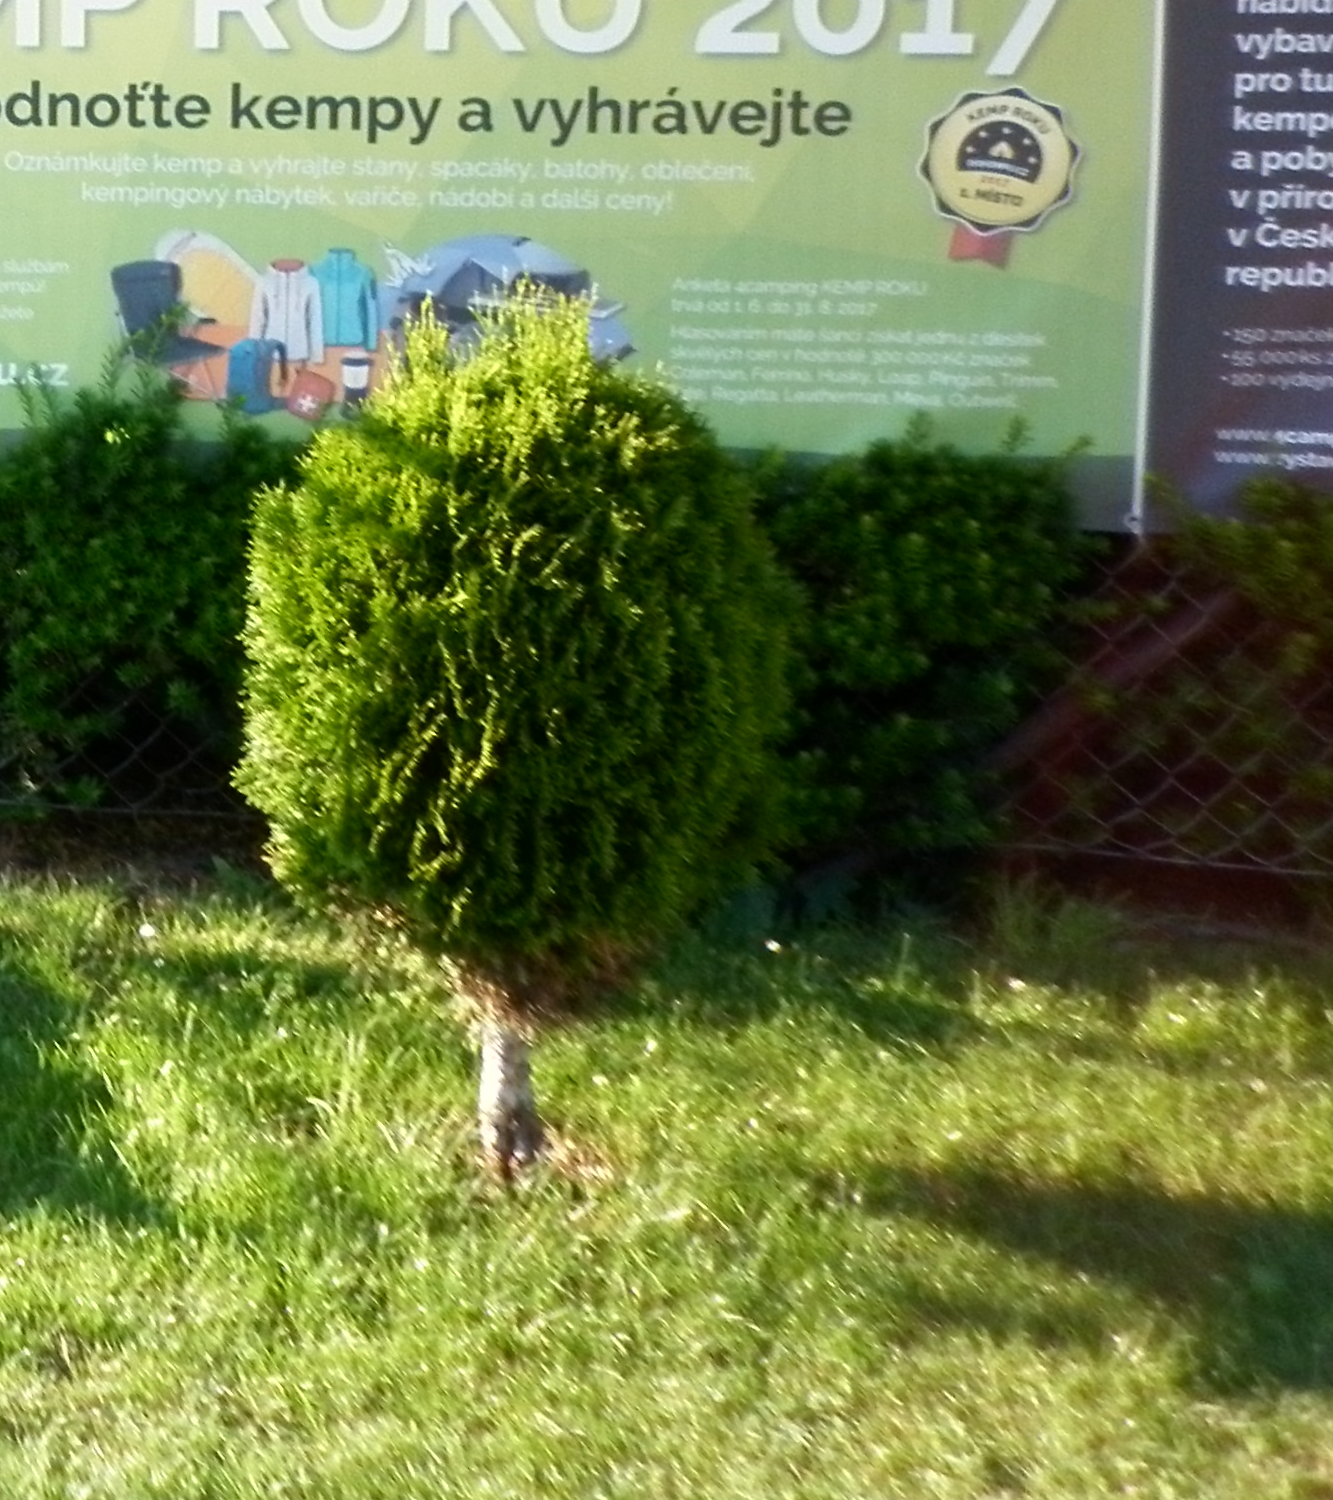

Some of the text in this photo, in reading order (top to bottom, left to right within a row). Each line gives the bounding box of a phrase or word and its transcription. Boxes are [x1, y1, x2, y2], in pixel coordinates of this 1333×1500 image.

[1233, 72, 1292, 99] pro
[230, 81, 441, 146] kempy
[457, 96, 493, 136] a
[514, 86, 852, 148] vyhrávejte
[1232, 105, 1333, 138] kemp
[4, 150, 148, 177] Oznámkujte
[153, 152, 223, 178] kemp
[229, 158, 243, 174] a
[249, 155, 347, 179] vyhrajte
[1230, 150, 1253, 171] a
[81, 180, 229, 209] kempingový
[429, 188, 515, 208] nádobí
[519, 193, 535, 208] a
[1228, 189, 1250, 209] v
[1226, 228, 1248, 248] v
